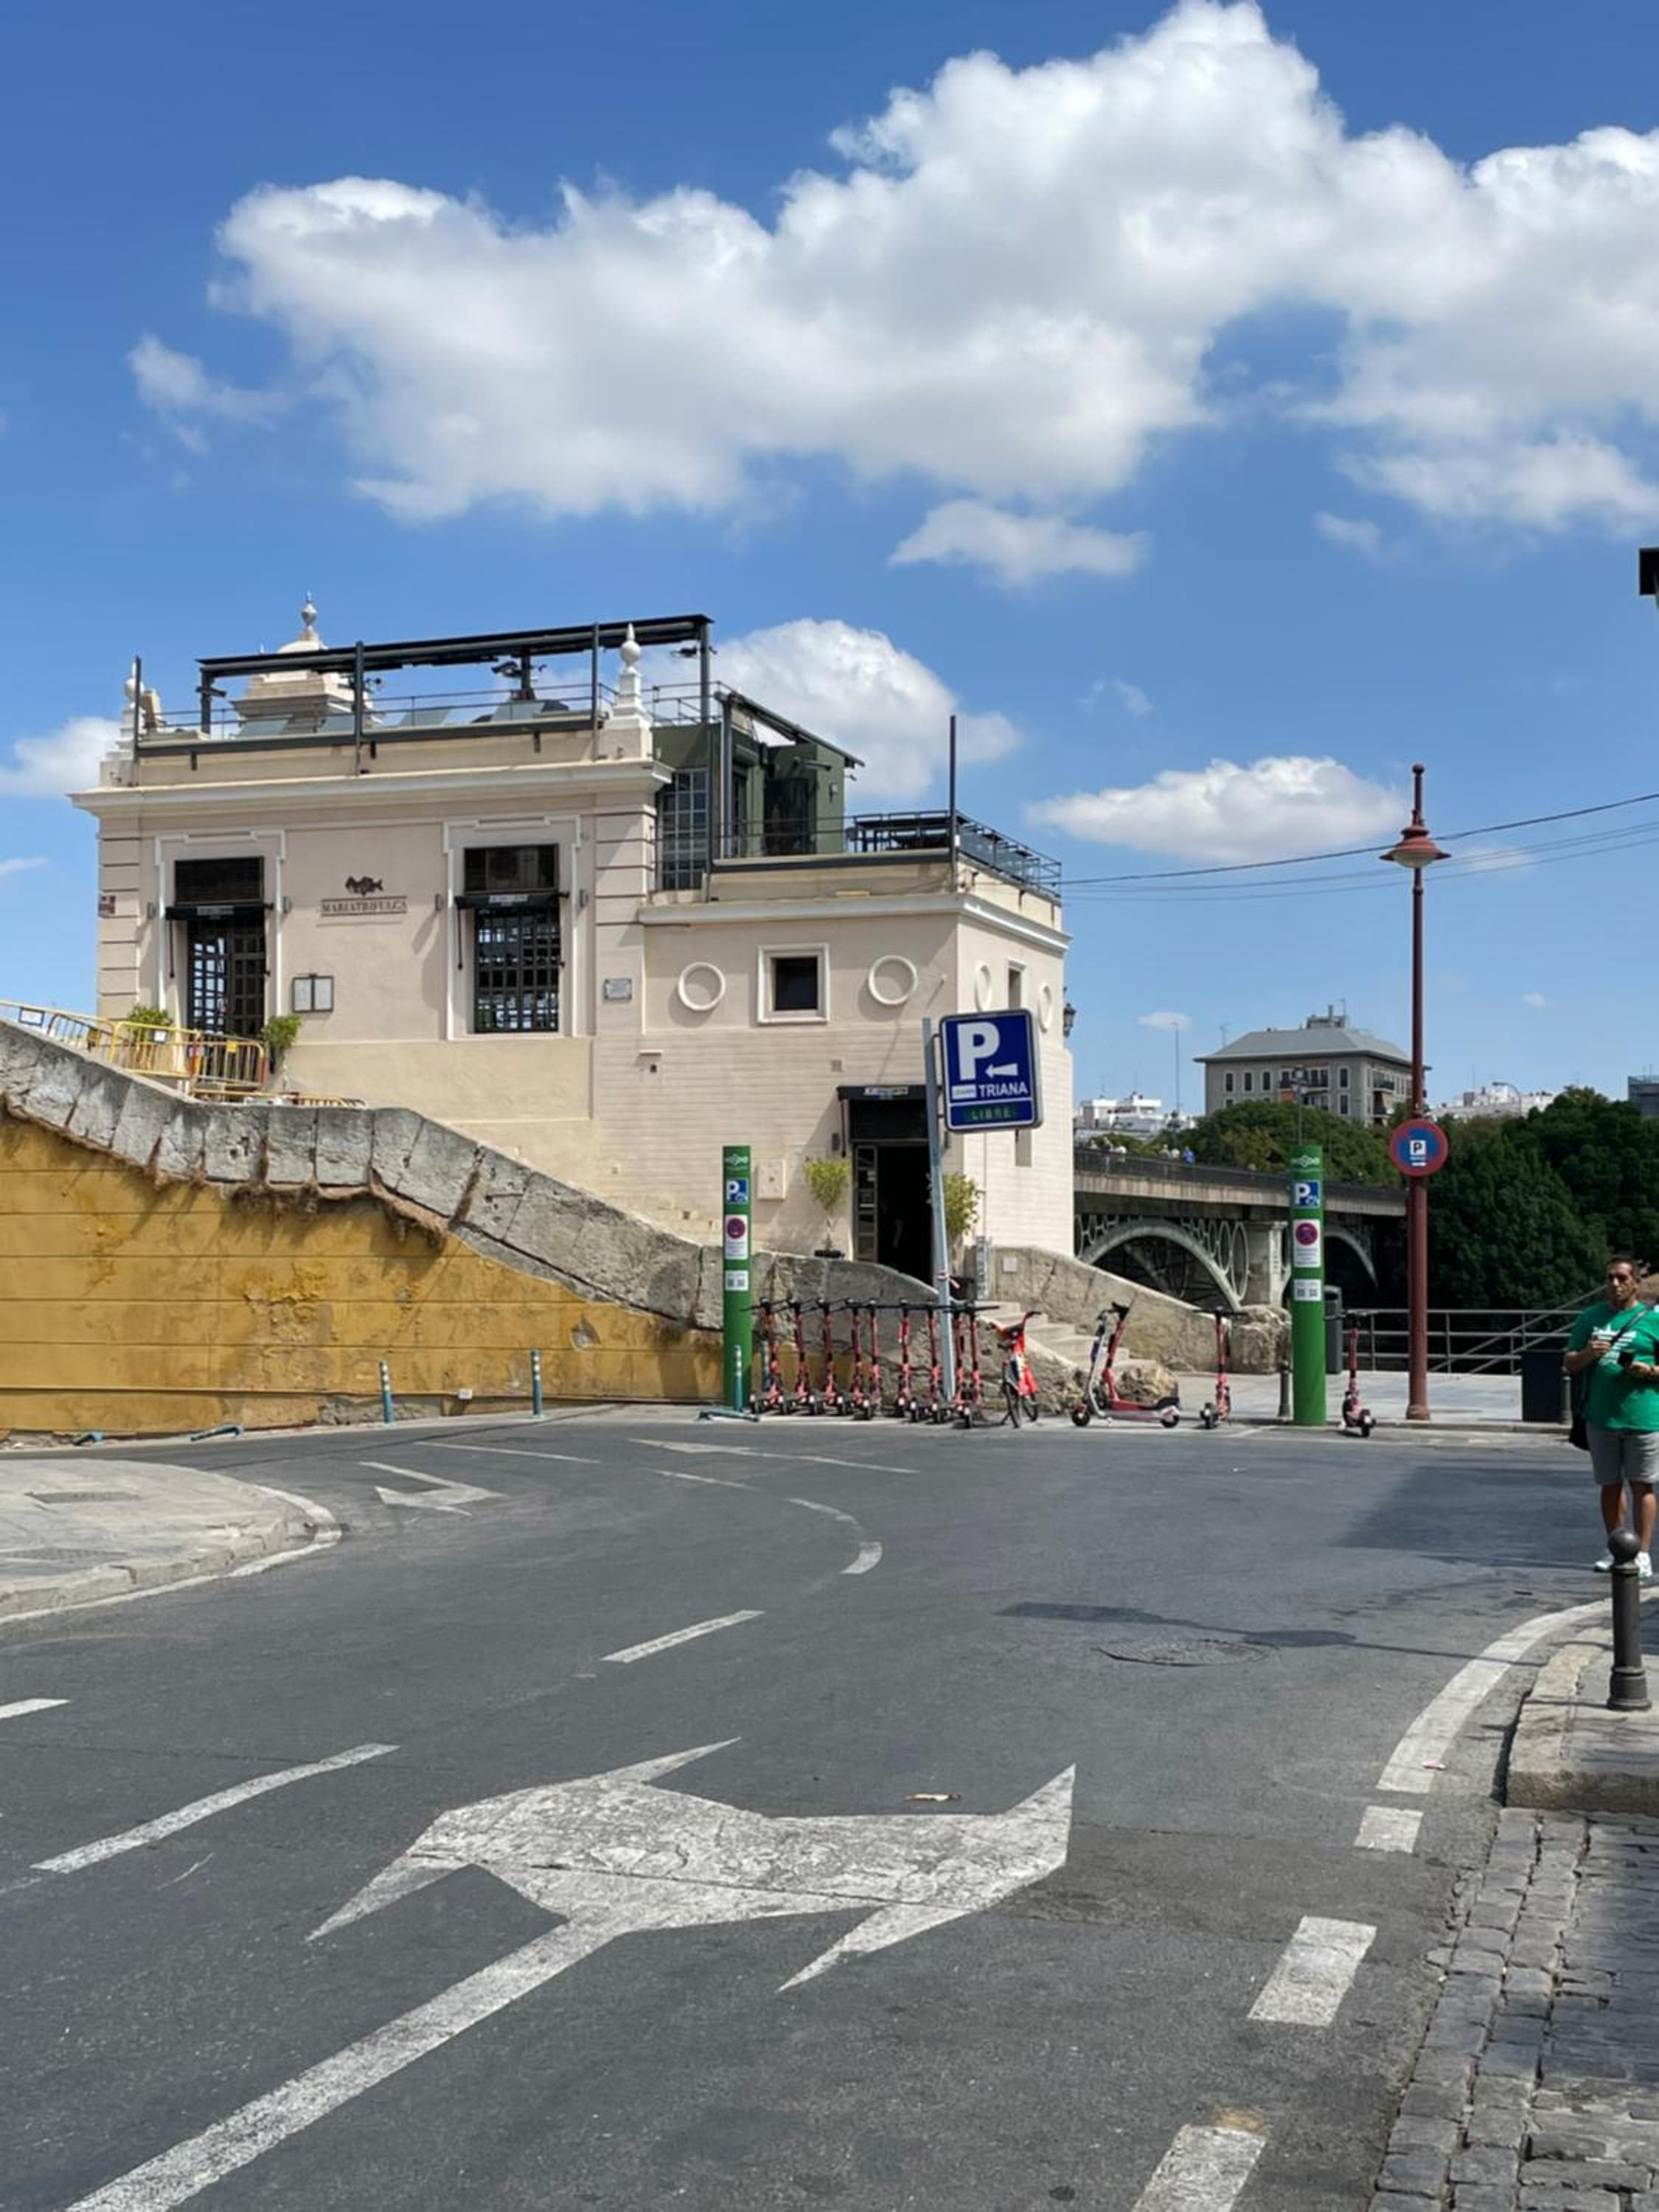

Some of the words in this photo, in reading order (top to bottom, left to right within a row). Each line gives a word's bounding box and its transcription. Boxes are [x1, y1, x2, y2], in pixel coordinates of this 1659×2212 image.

[958, 1022, 1000, 1080] P
[978, 1082, 1028, 1098] TRIANA
[971, 1107, 1012, 1120] LIBRE
[726, 1180, 740, 1201] P
[1295, 1184, 1310, 1204] P
